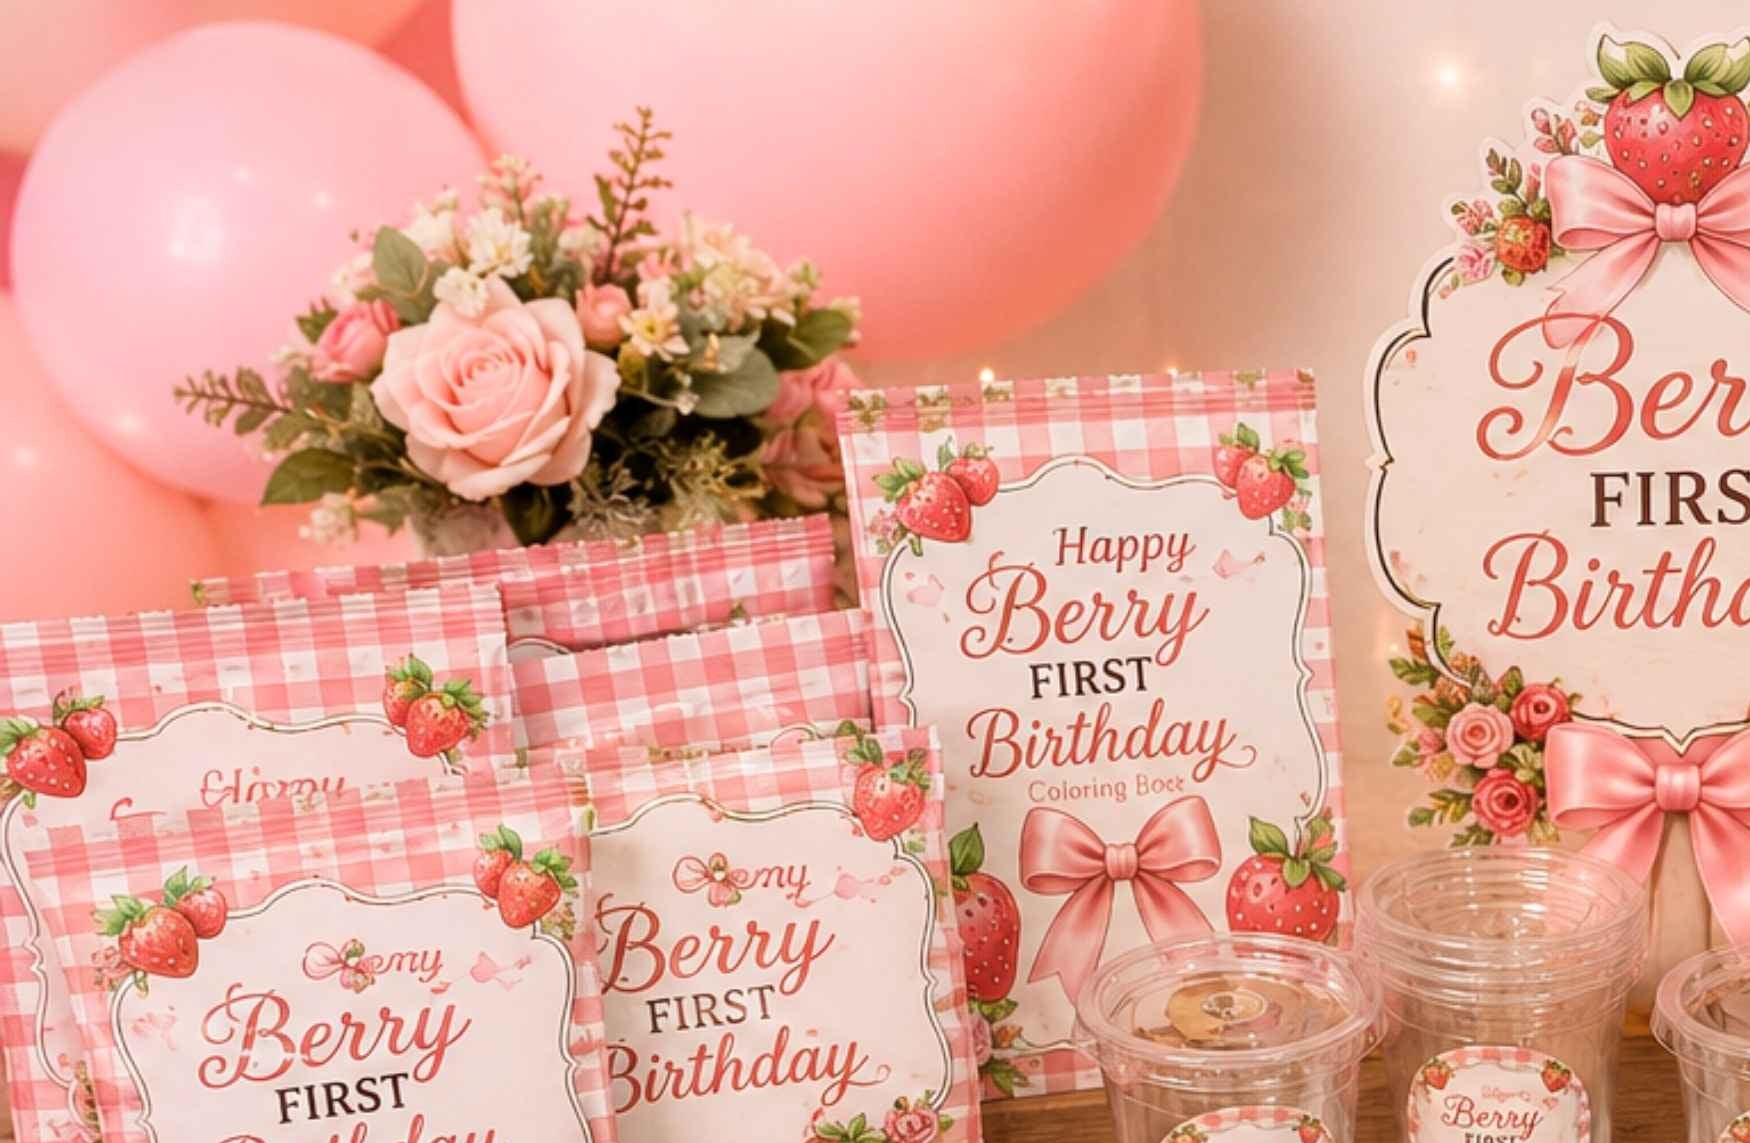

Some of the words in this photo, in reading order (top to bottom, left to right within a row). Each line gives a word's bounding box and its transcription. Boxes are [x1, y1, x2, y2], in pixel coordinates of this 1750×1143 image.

[1052, 526, 1195, 573] Happy
[961, 552, 1209, 666] Berry
[1029, 657, 1152, 699] FIRST
[967, 698, 1256, 782] Birthday
[1028, 778, 1127, 803] Coloring
[595, 893, 836, 996] Berry
[198, 982, 471, 1087] Berry
[646, 985, 775, 1033] FIRST
[606, 1025, 891, 1113] Birthday
[275, 1073, 409, 1125] FIRST
[1441, 1094, 1543, 1140] Berry
